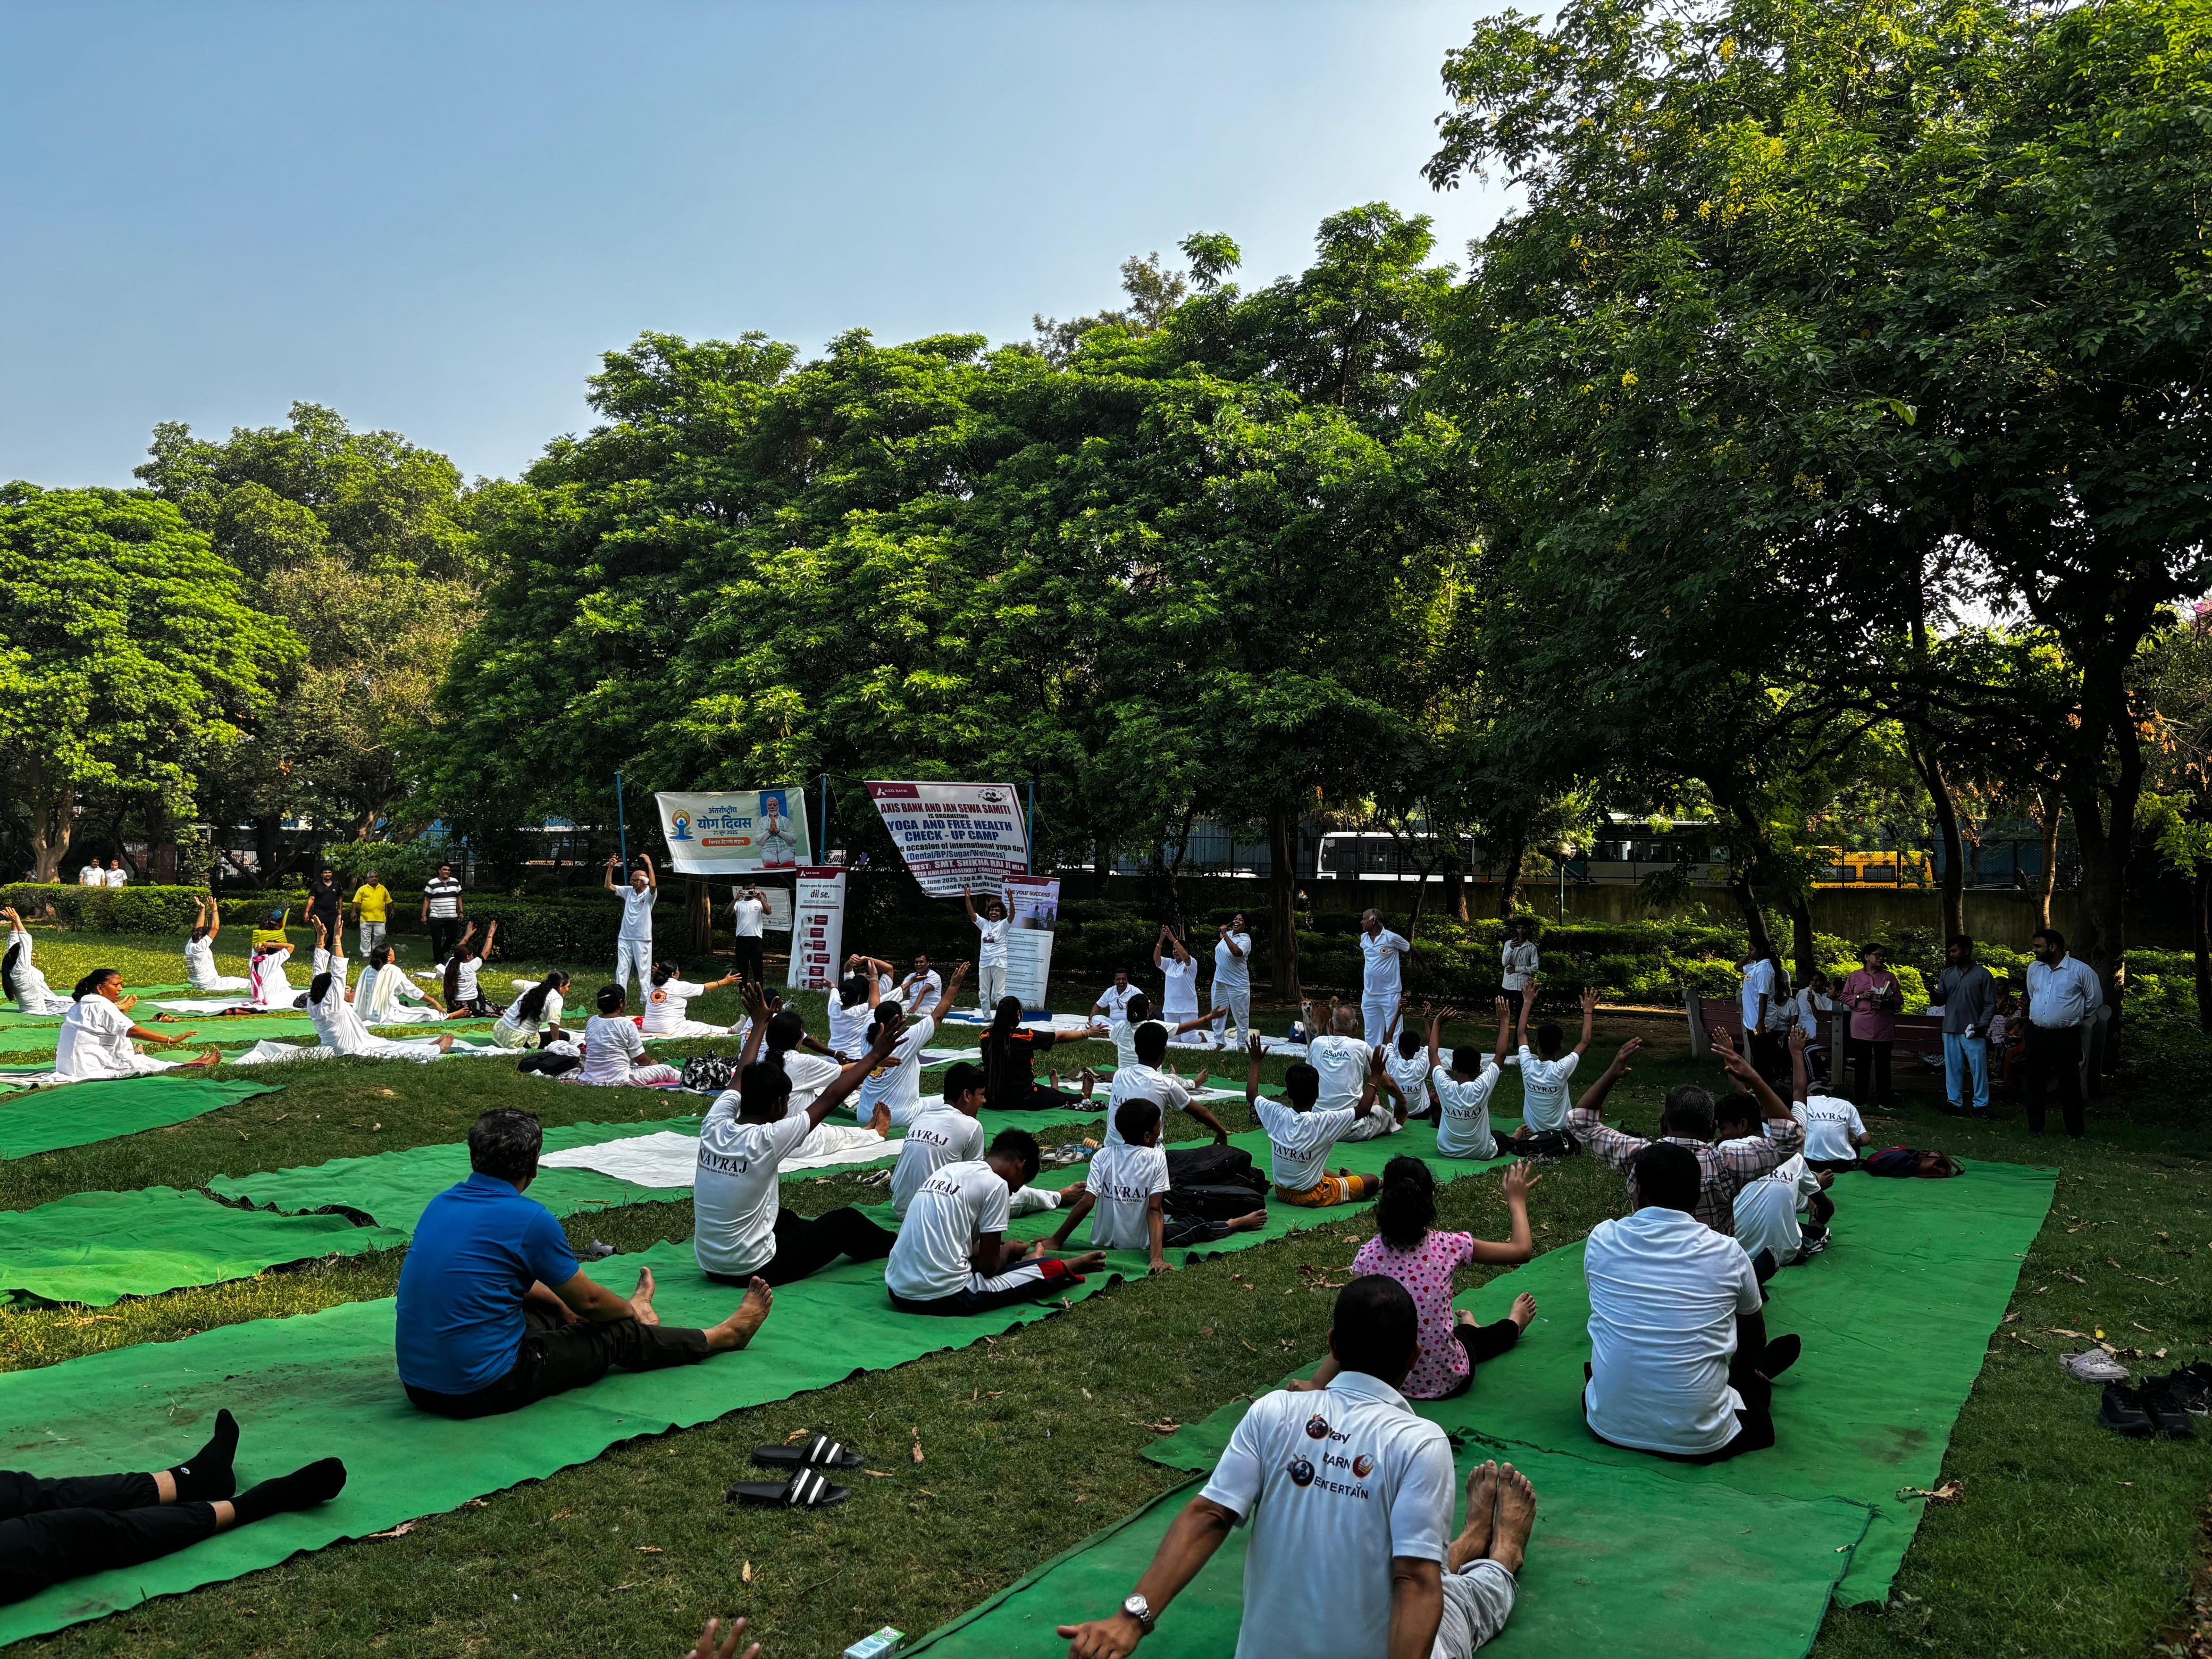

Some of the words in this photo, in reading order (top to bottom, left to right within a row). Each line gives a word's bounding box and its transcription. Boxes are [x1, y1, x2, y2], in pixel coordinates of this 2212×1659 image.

[881, 803, 900, 814] AXIS
[901, 803, 924, 812] BANK
[925, 803, 941, 812] AND
[943, 803, 957, 812] JAN
[957, 804, 982, 814] SEWA
[984, 805, 1011, 815] SAMITI
[697, 816, 719, 830] योग
[721, 815, 752, 830] दिवस
[887, 820, 919, 831] YOGA
[923, 820, 945, 829] AND
[948, 820, 971, 829] FREE
[974, 820, 1012, 831] HEALTH
[905, 831, 943, 842] CHECK
[951, 831, 965, 840] UP
[968, 831, 999, 841] CAMP
[907, 850, 1006, 861] (Dental/BP/Sugar/Wellness)
[957, 859, 989, 867] SHIKHA
[810, 889, 819, 898] dil
[1323, 1049, 1351, 1058] ASANA
[1527, 1083, 1557, 1093] NAVRAJ
[1445, 1106, 1481, 1118] NAVRAJ
